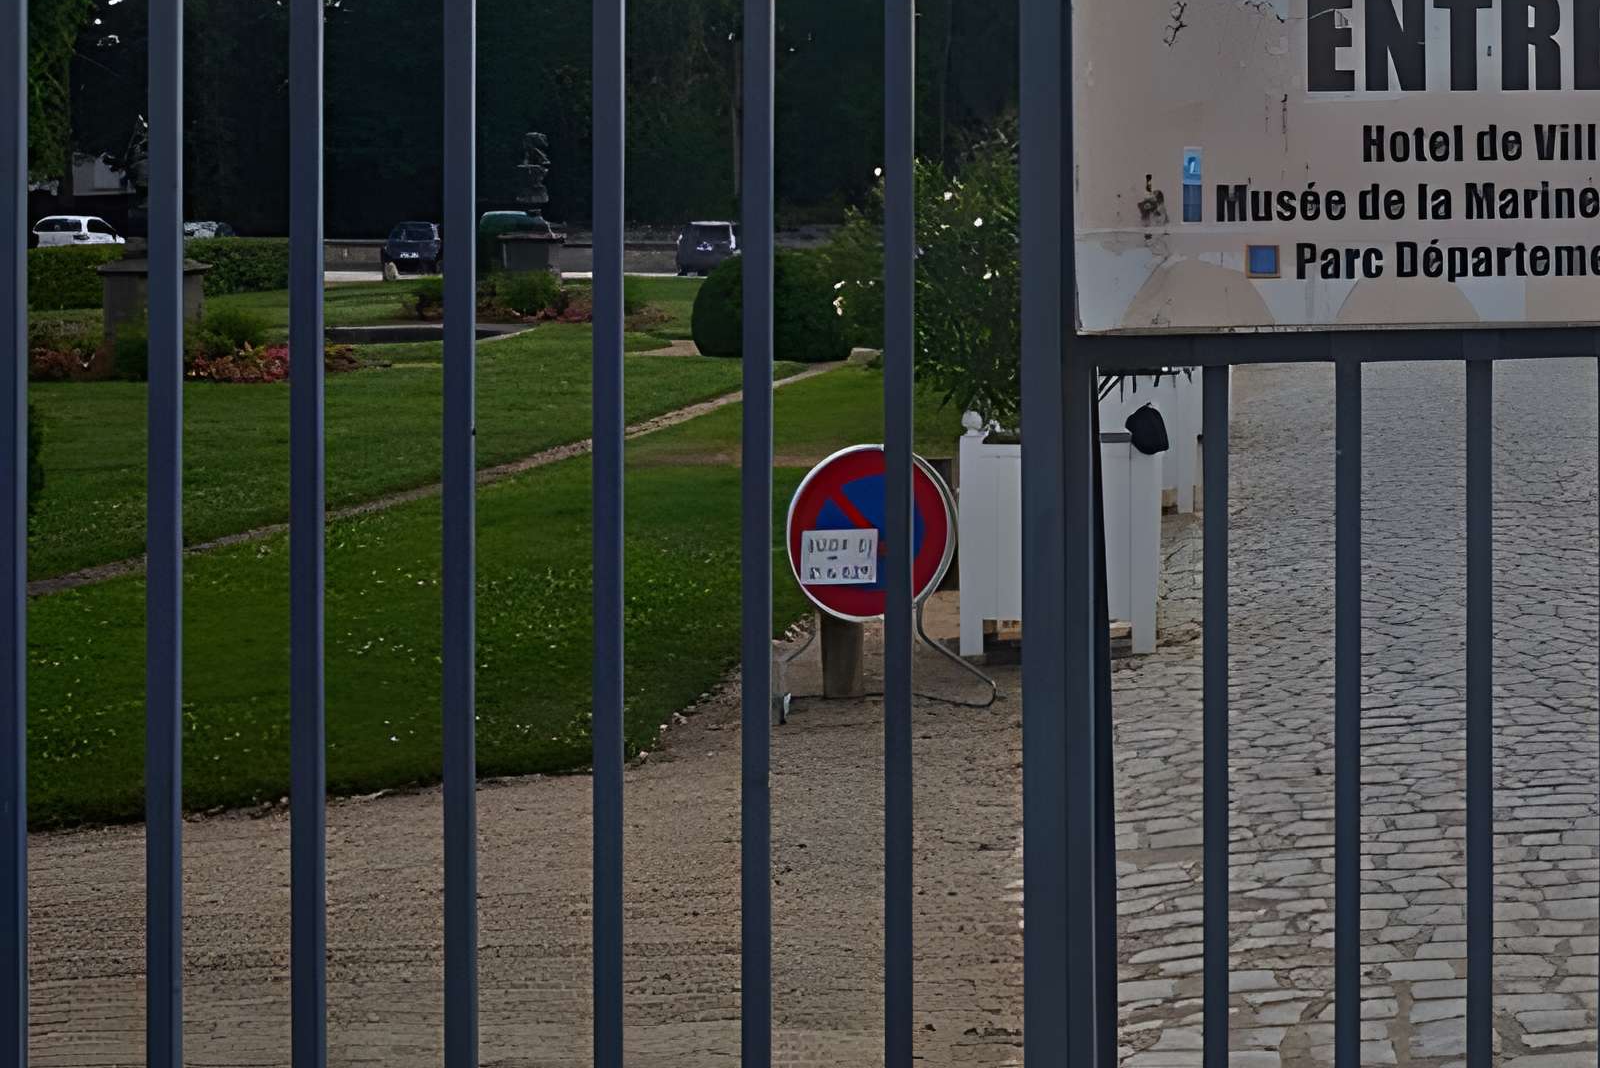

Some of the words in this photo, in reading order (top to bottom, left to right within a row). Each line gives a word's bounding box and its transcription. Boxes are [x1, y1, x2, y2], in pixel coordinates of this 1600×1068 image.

[1362, 124, 1464, 163] Hotel
[1476, 124, 1523, 162] de
[1215, 182, 1347, 223] Musée
[1358, 183, 1406, 221] de
[1417, 182, 1453, 221] la
[1465, 181, 1600, 220] Marine
[1295, 242, 1385, 280] Parc
